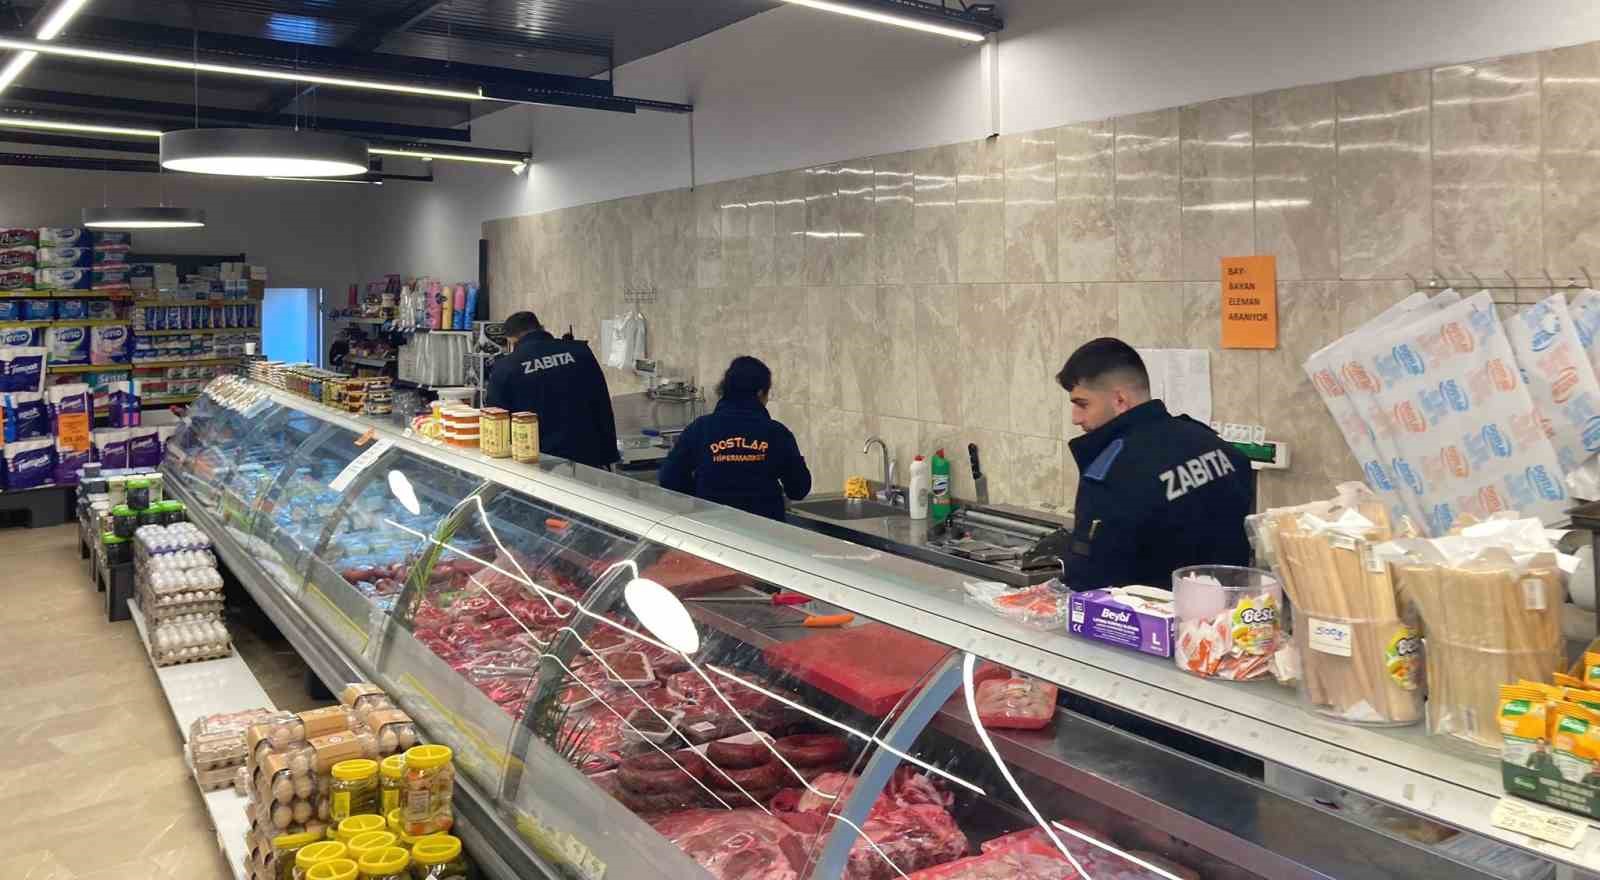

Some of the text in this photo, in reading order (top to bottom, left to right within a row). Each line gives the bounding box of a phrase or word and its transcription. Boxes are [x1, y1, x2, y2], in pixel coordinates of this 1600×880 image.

[521, 352, 576, 375] ZABITA
[710, 436, 769, 453] DOSTLAR
[1159, 448, 1236, 502] ZABITA
[1101, 607, 1131, 623] Beybi
[1151, 632, 1161, 646] L
